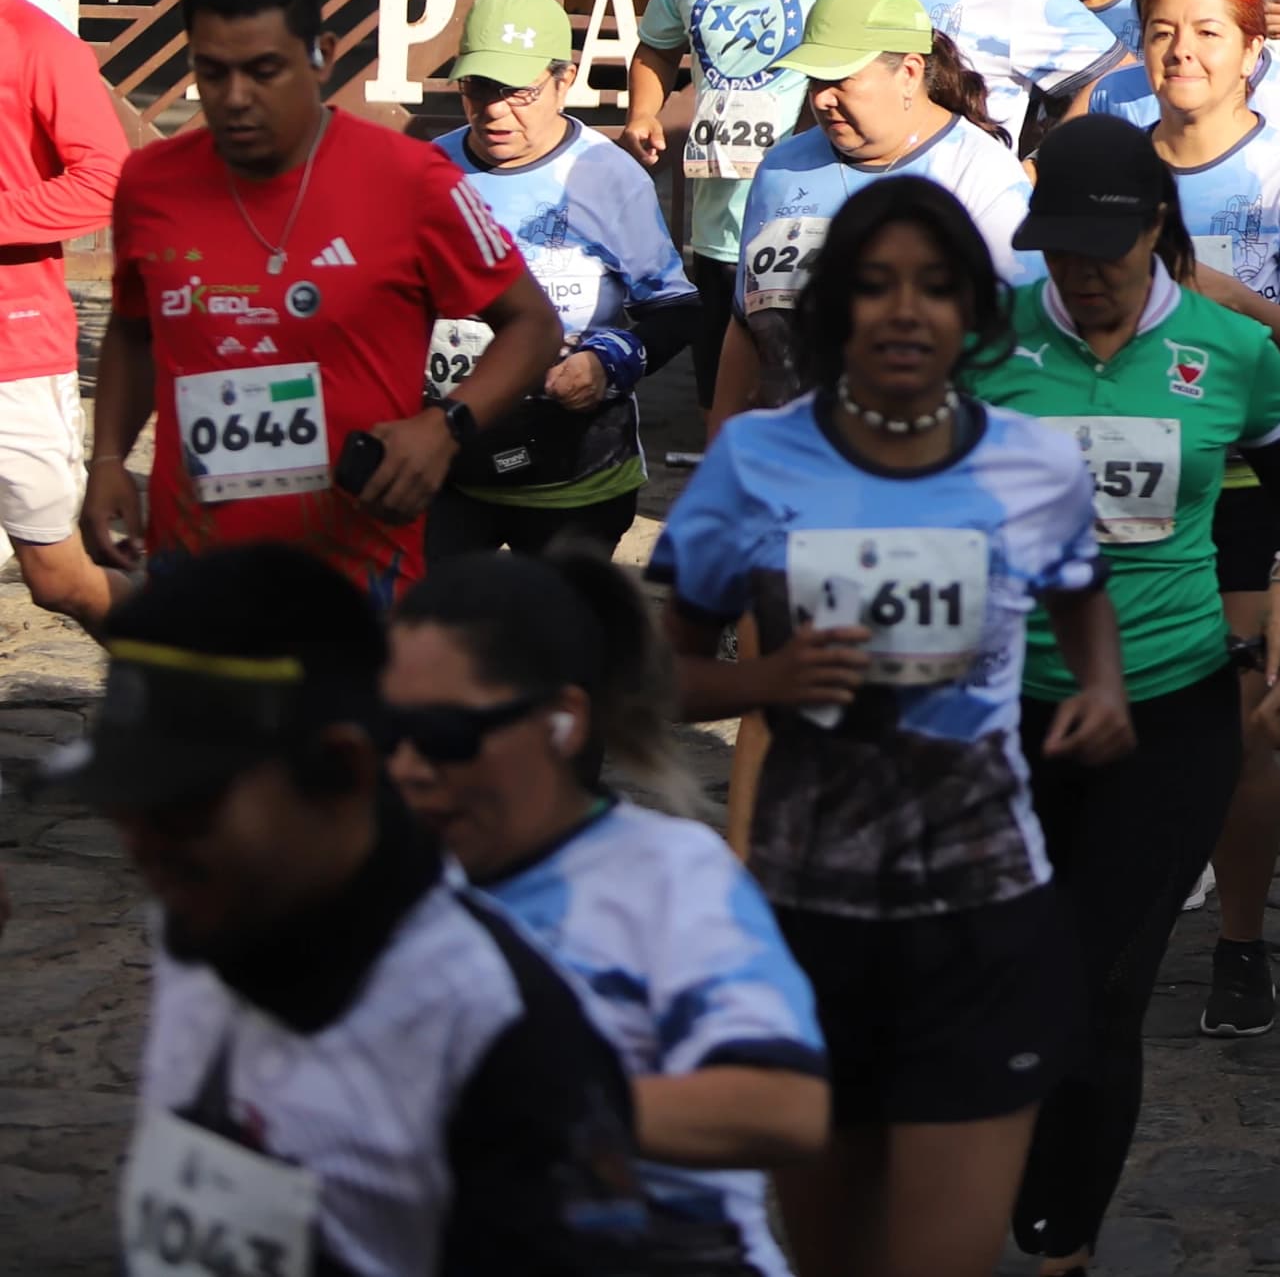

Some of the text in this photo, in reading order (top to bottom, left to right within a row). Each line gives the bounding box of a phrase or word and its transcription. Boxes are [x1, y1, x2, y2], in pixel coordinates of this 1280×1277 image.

[694, 119, 775, 148] 0428
[775, 202, 820, 218] sporelli
[190, 406, 320, 456] 0646
[870, 579, 962, 626] 611
